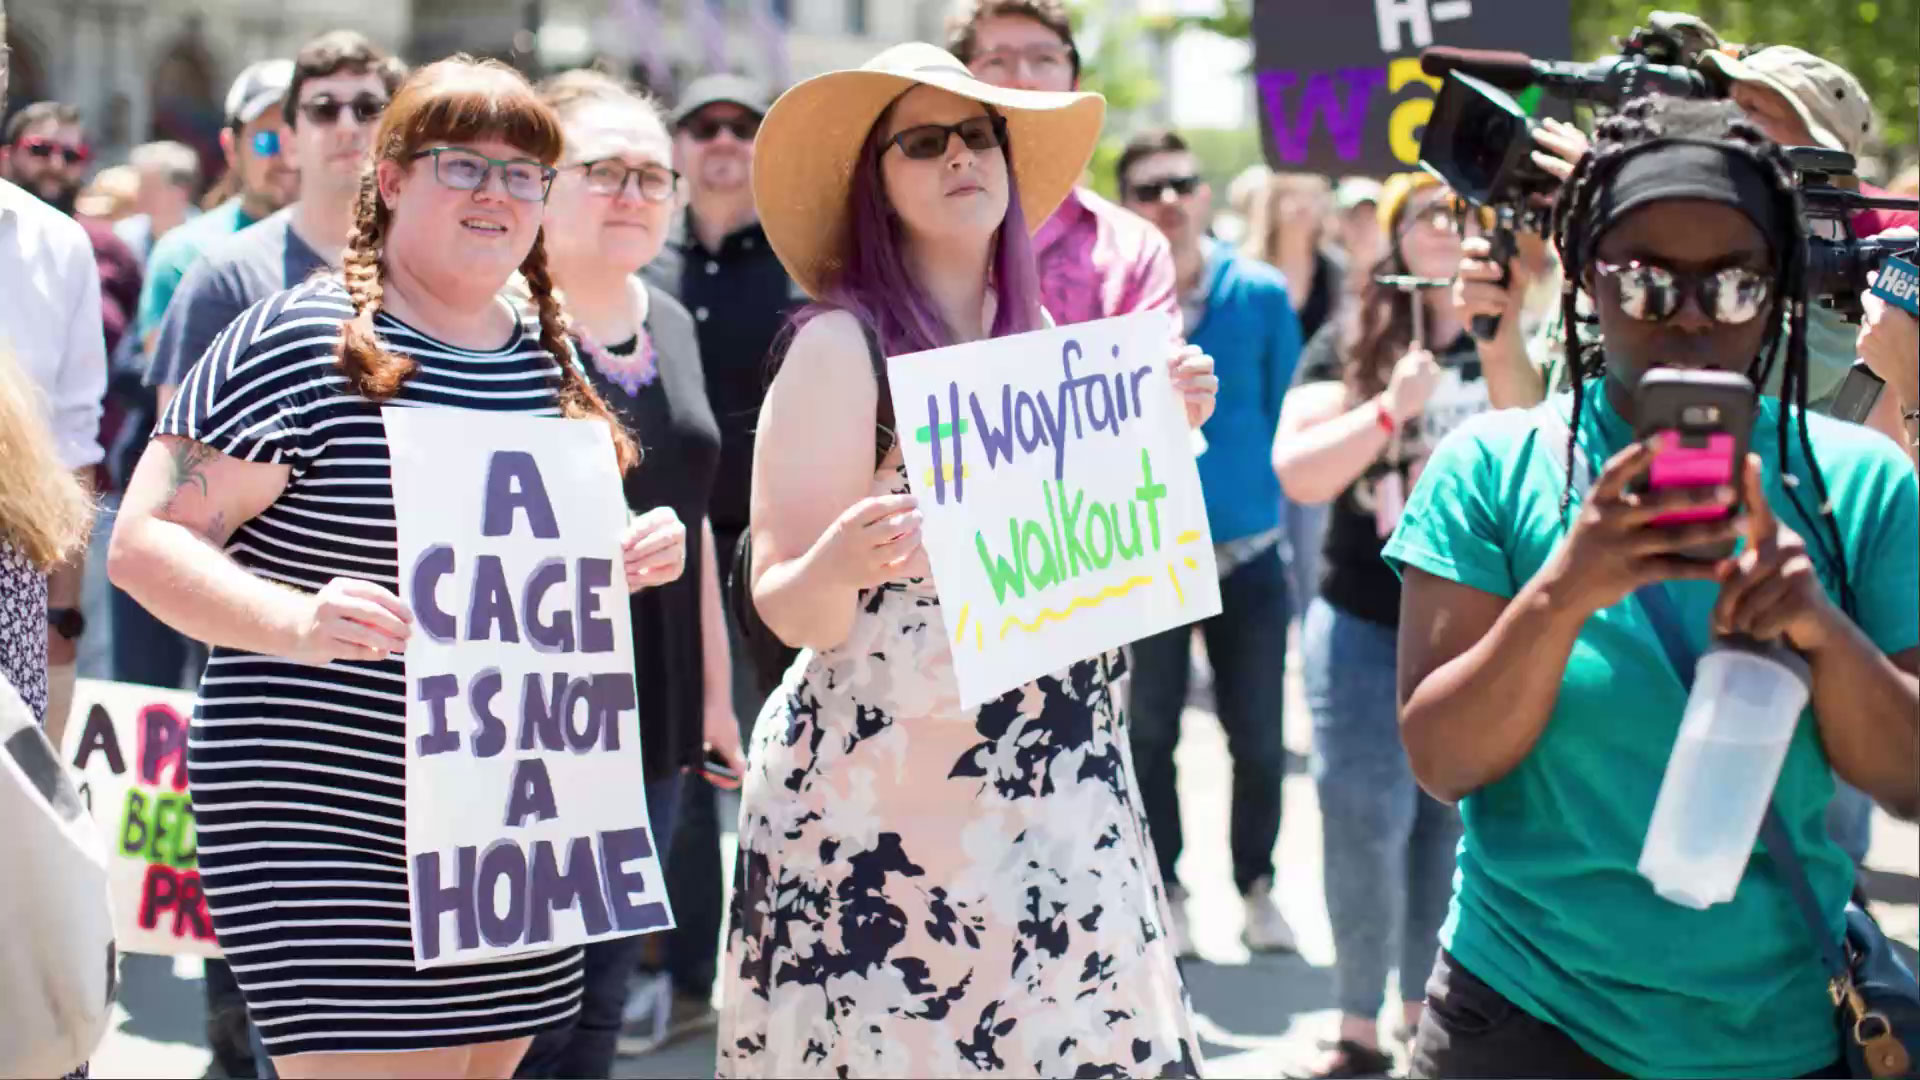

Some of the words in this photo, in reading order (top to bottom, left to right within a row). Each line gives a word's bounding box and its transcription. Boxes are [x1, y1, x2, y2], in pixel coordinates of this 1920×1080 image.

[1257, 57, 1444, 166] Wa
[481, 450, 561, 539] A
[975, 447, 1167, 605] walkout
[410, 543, 615, 653] CAGE
[73, 703, 126, 775] A
[416, 666, 507, 758] IS
[516, 671, 637, 755] NOT
[503, 757, 560, 829] A
[412, 827, 671, 960] HOME
